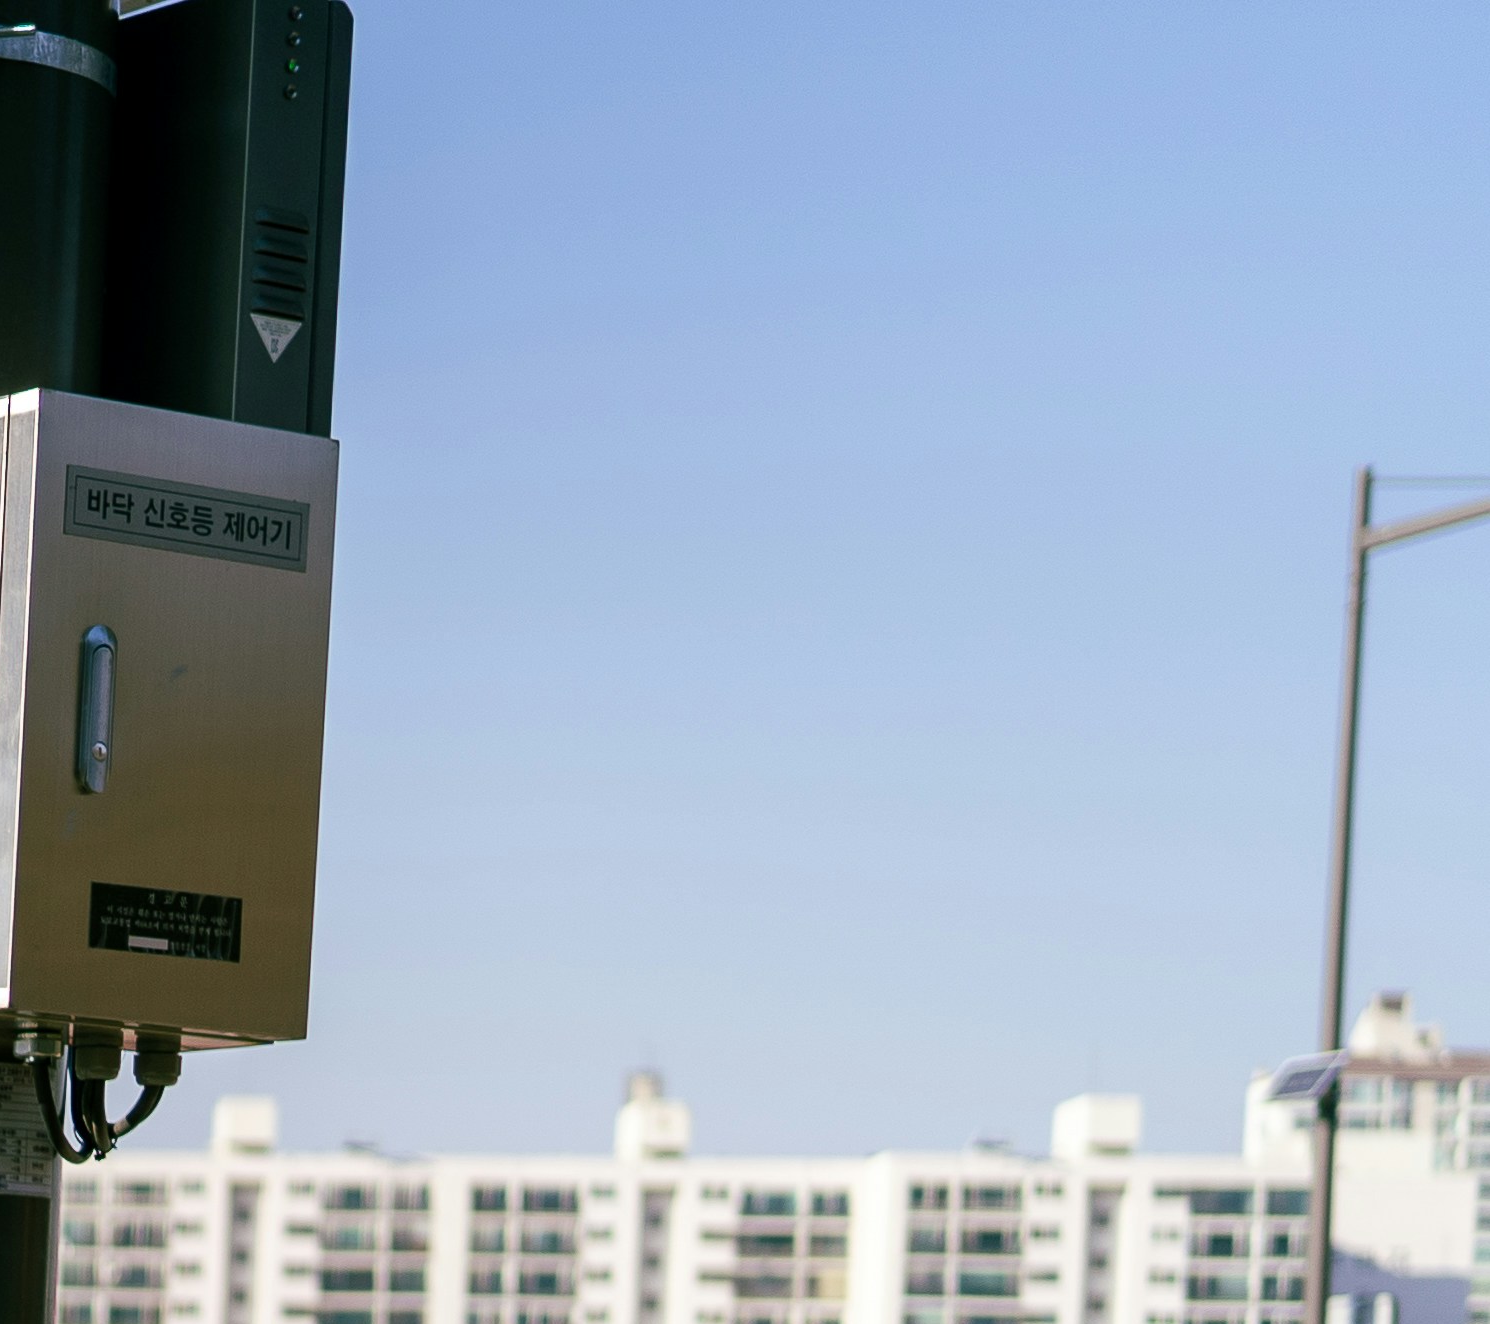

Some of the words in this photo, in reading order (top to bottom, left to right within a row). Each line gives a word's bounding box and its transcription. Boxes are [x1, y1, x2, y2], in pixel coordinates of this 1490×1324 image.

[87, 488, 134, 523] 바닥
[144, 498, 214, 537] 신호등
[223, 512, 292, 549] 제어기
